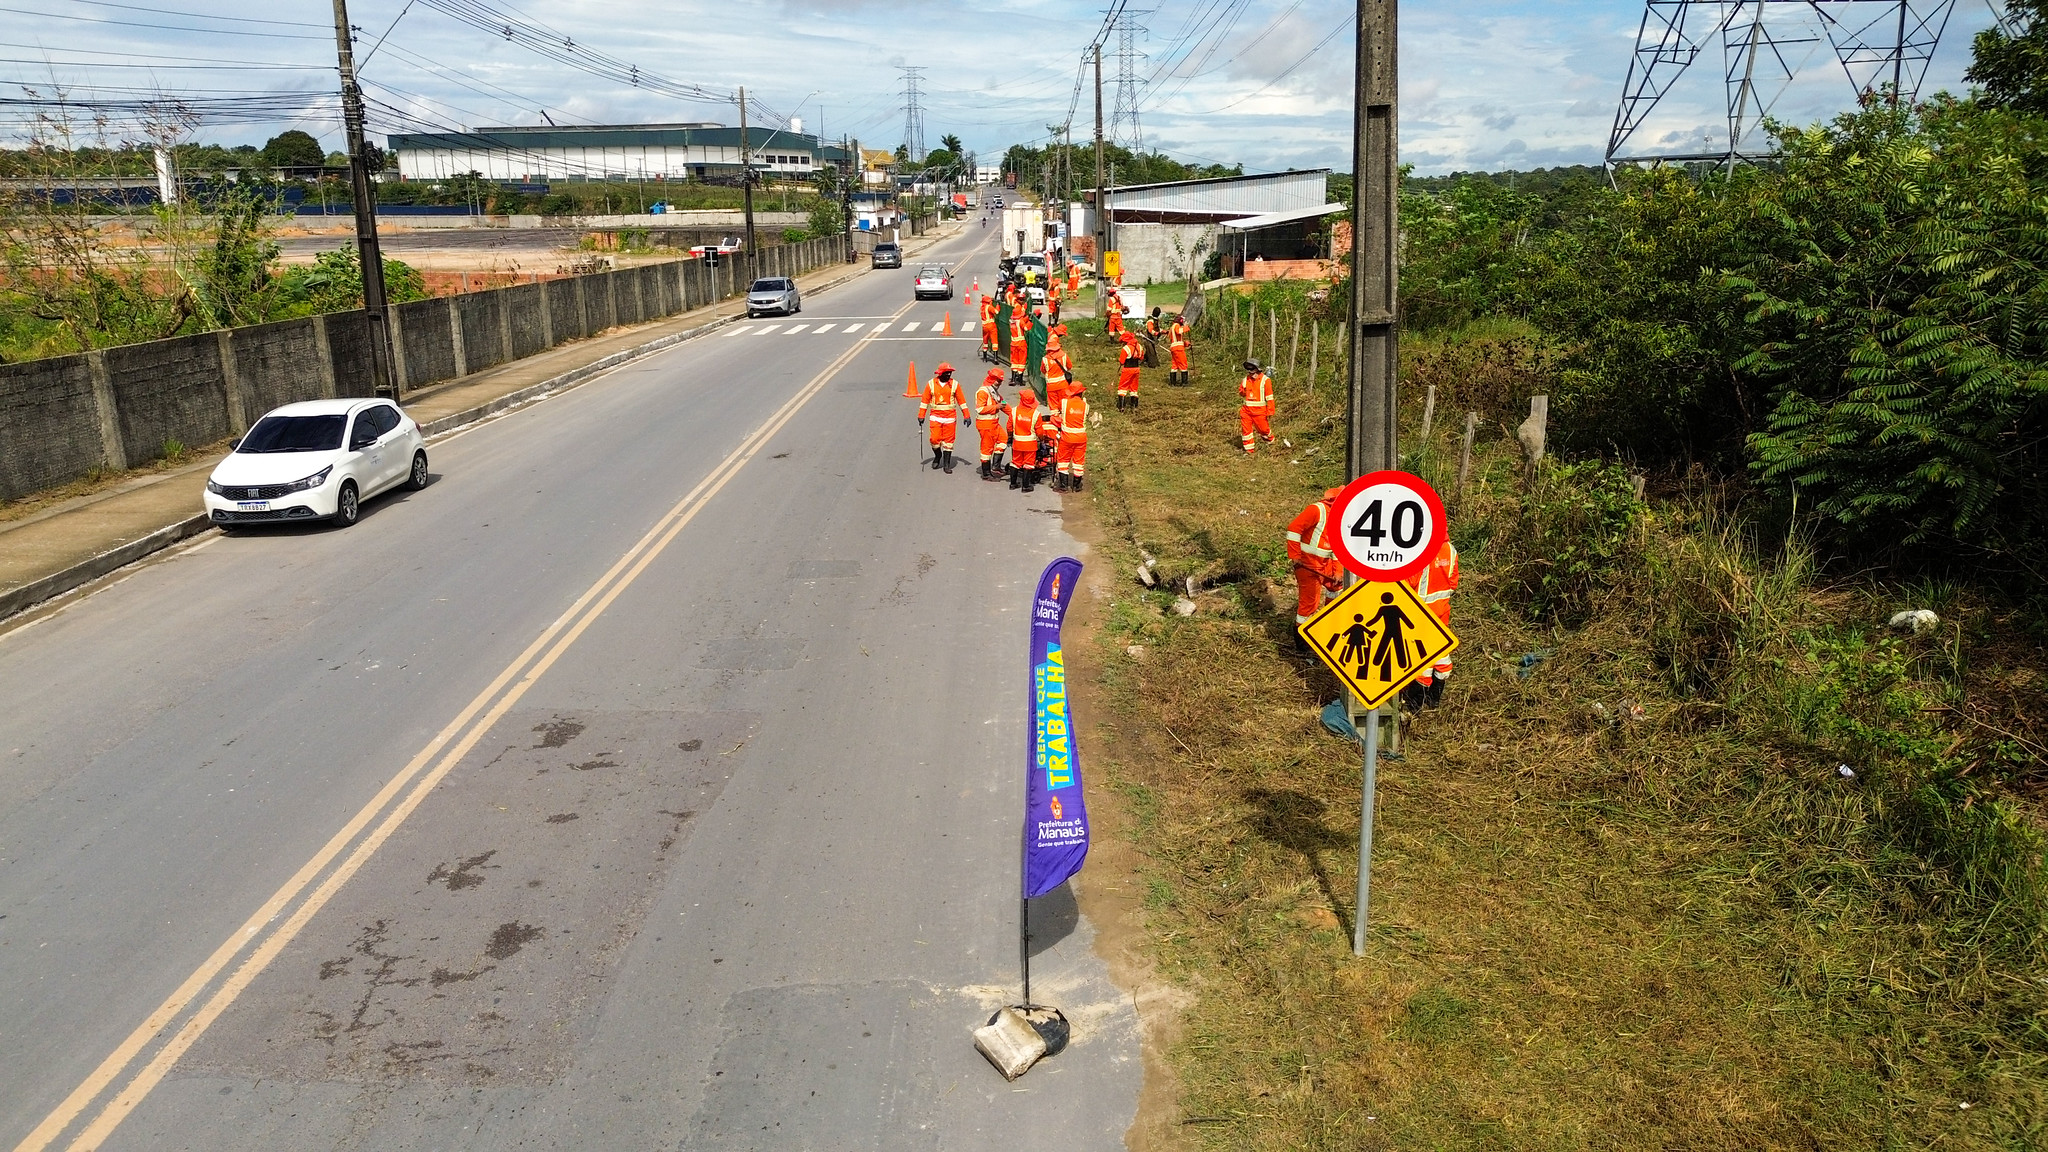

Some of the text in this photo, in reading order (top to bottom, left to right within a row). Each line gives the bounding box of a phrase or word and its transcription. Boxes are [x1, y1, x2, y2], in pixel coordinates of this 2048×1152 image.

[247, 488, 260, 498] FIAT
[1350, 499, 1424, 549] 40
[1367, 550, 1403, 562] km/h
[1037, 606, 1058, 620] Mana
[1036, 667, 1046, 766] GENTE QUE
[1047, 649, 1070, 787] TRABALHA
[1038, 820, 1073, 829] Prefeitura
[1038, 827, 1085, 840] Manaus
